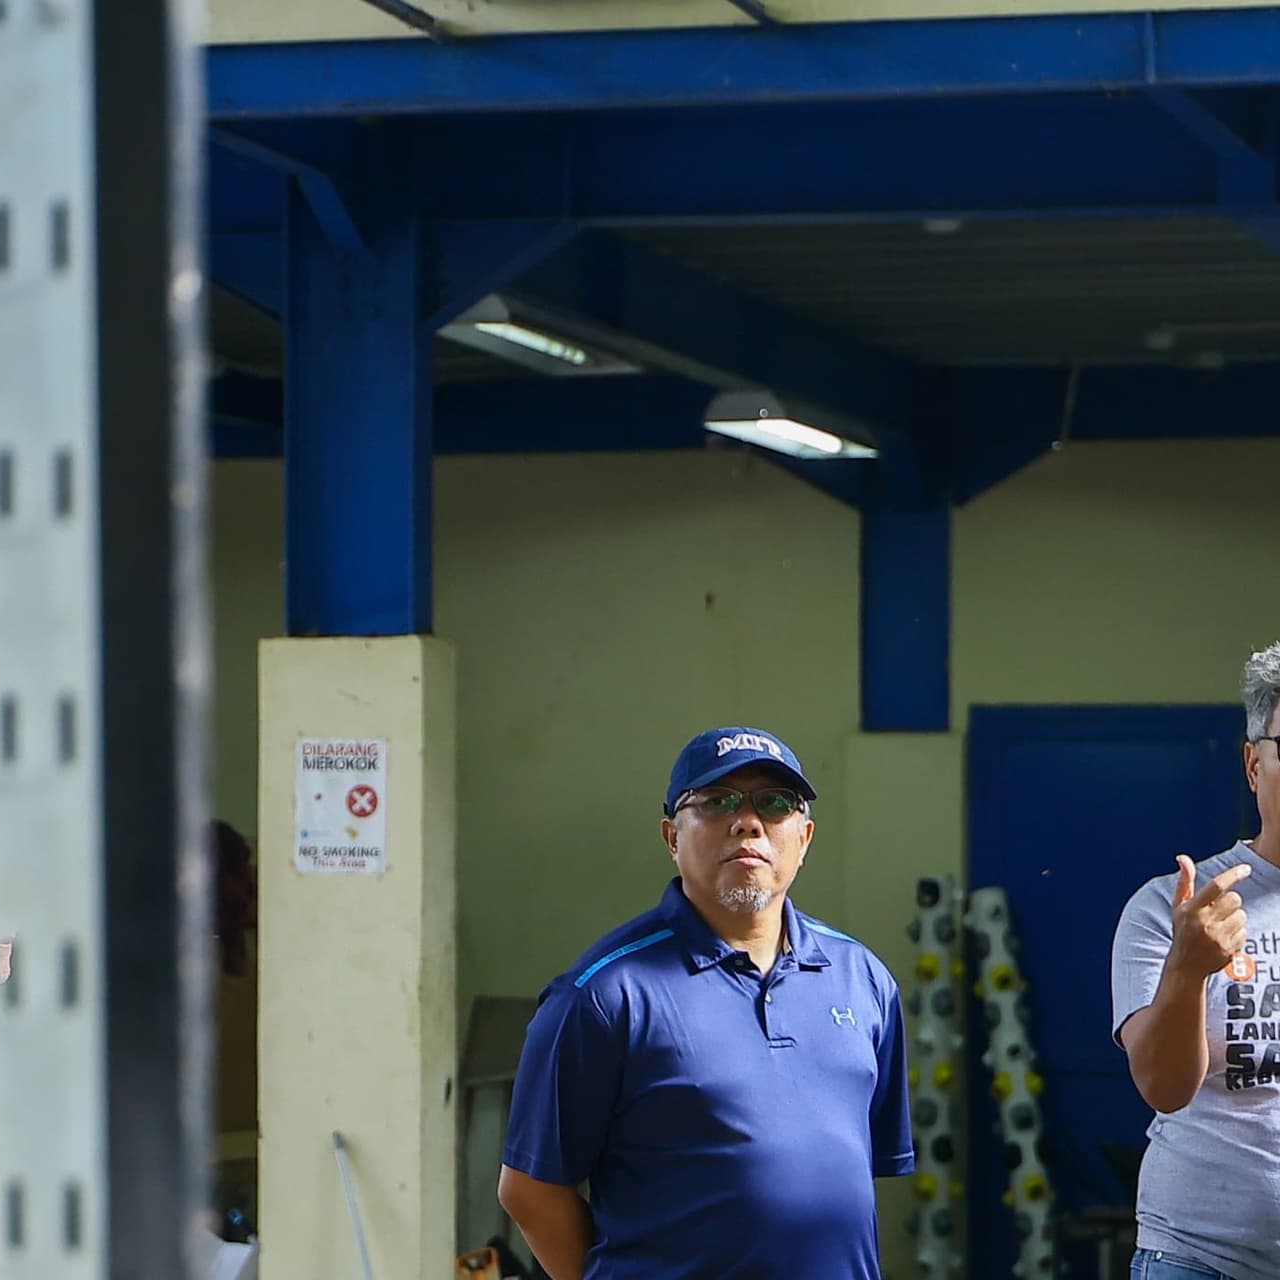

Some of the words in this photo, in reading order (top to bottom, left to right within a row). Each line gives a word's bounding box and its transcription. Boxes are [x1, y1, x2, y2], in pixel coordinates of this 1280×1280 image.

[302, 743, 379, 756] DILARANG
[717, 733, 784, 762] MIT
[302, 756, 378, 770] MEROKOK
[299, 846, 318, 857] NO
[322, 846, 382, 857] SMOKING
